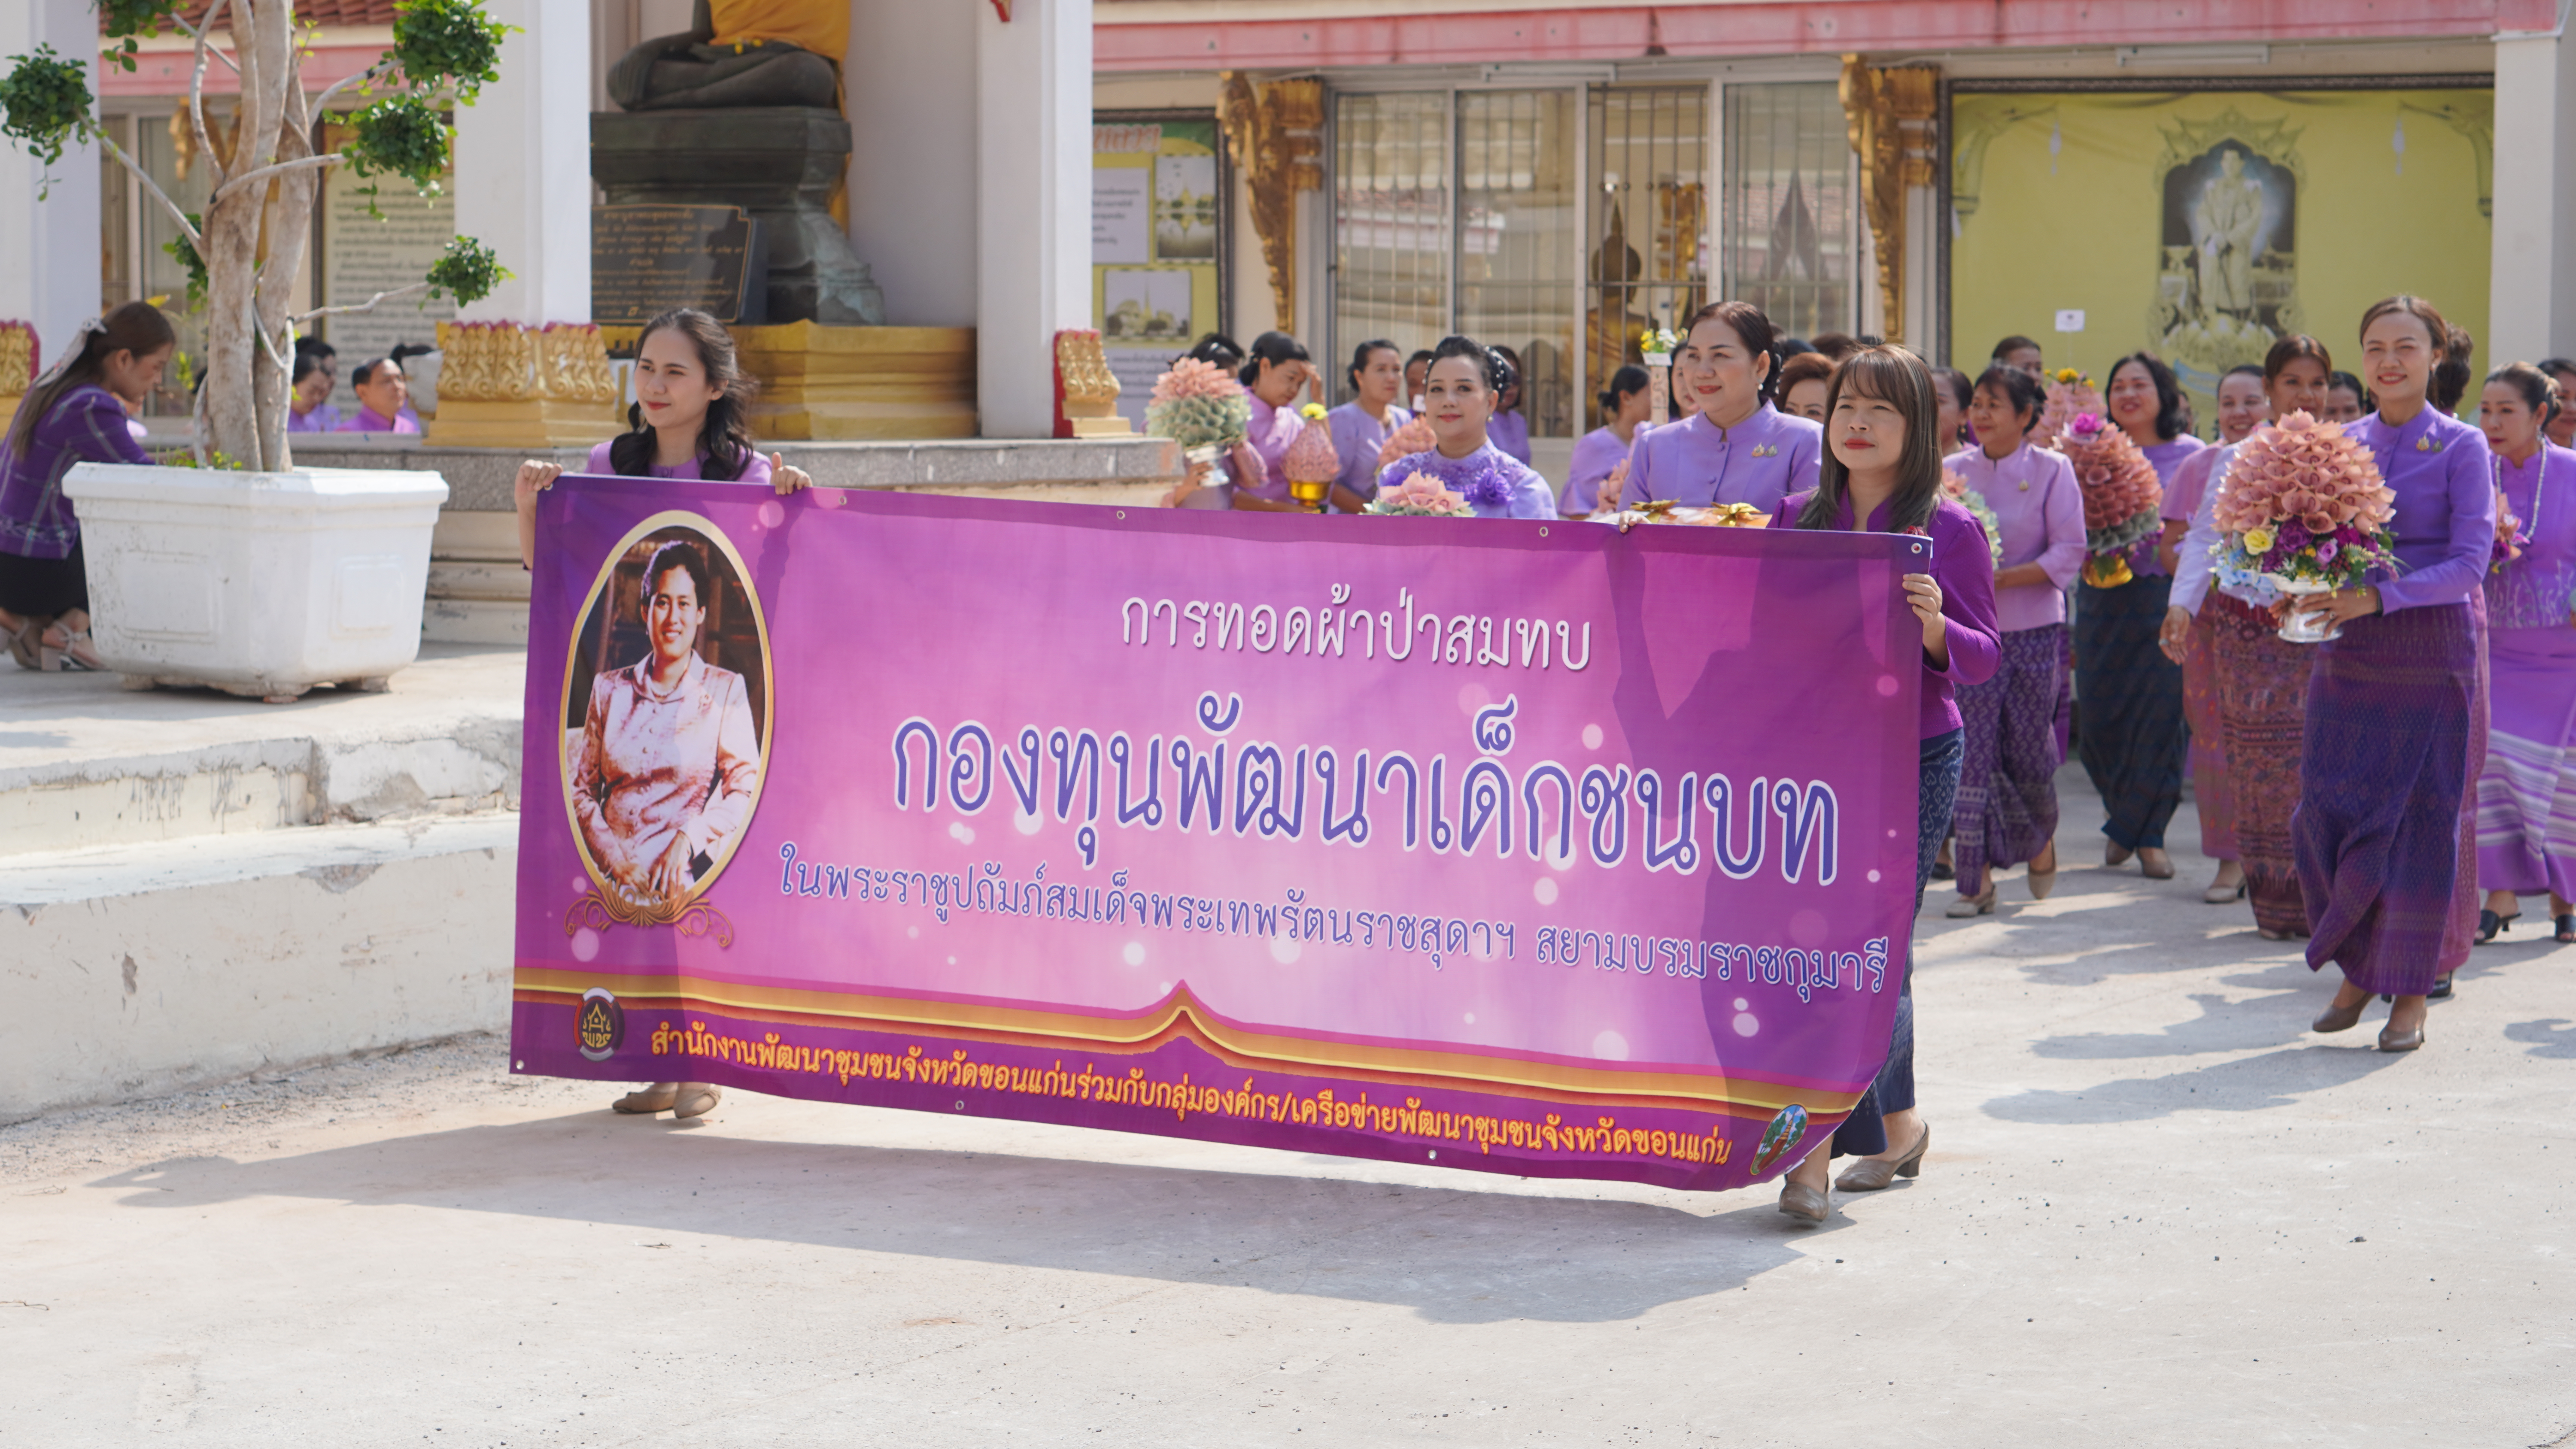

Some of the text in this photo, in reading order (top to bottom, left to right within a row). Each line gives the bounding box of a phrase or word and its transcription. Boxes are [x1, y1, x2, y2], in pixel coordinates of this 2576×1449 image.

[1121, 582, 1591, 671] การทอดผ้าป่าสมทบ
[891, 690, 1839, 887] กองทุนพัฒนาเด็กชนบท
[779, 840, 1889, 1003] ในพระราชูปถัมภ์สมเด็จพระเทพรัตนราชสุดาฯ สยามบรมราชกุมารี
[650, 1020, 1733, 1165] สำนักงานพัฒนาชุมชนจังหวัดขอนแก่นร่วมกับกลุ่มองค์กร/เครือข่ายพัฒนาชุมชนจังหวัดขอนแก่น
